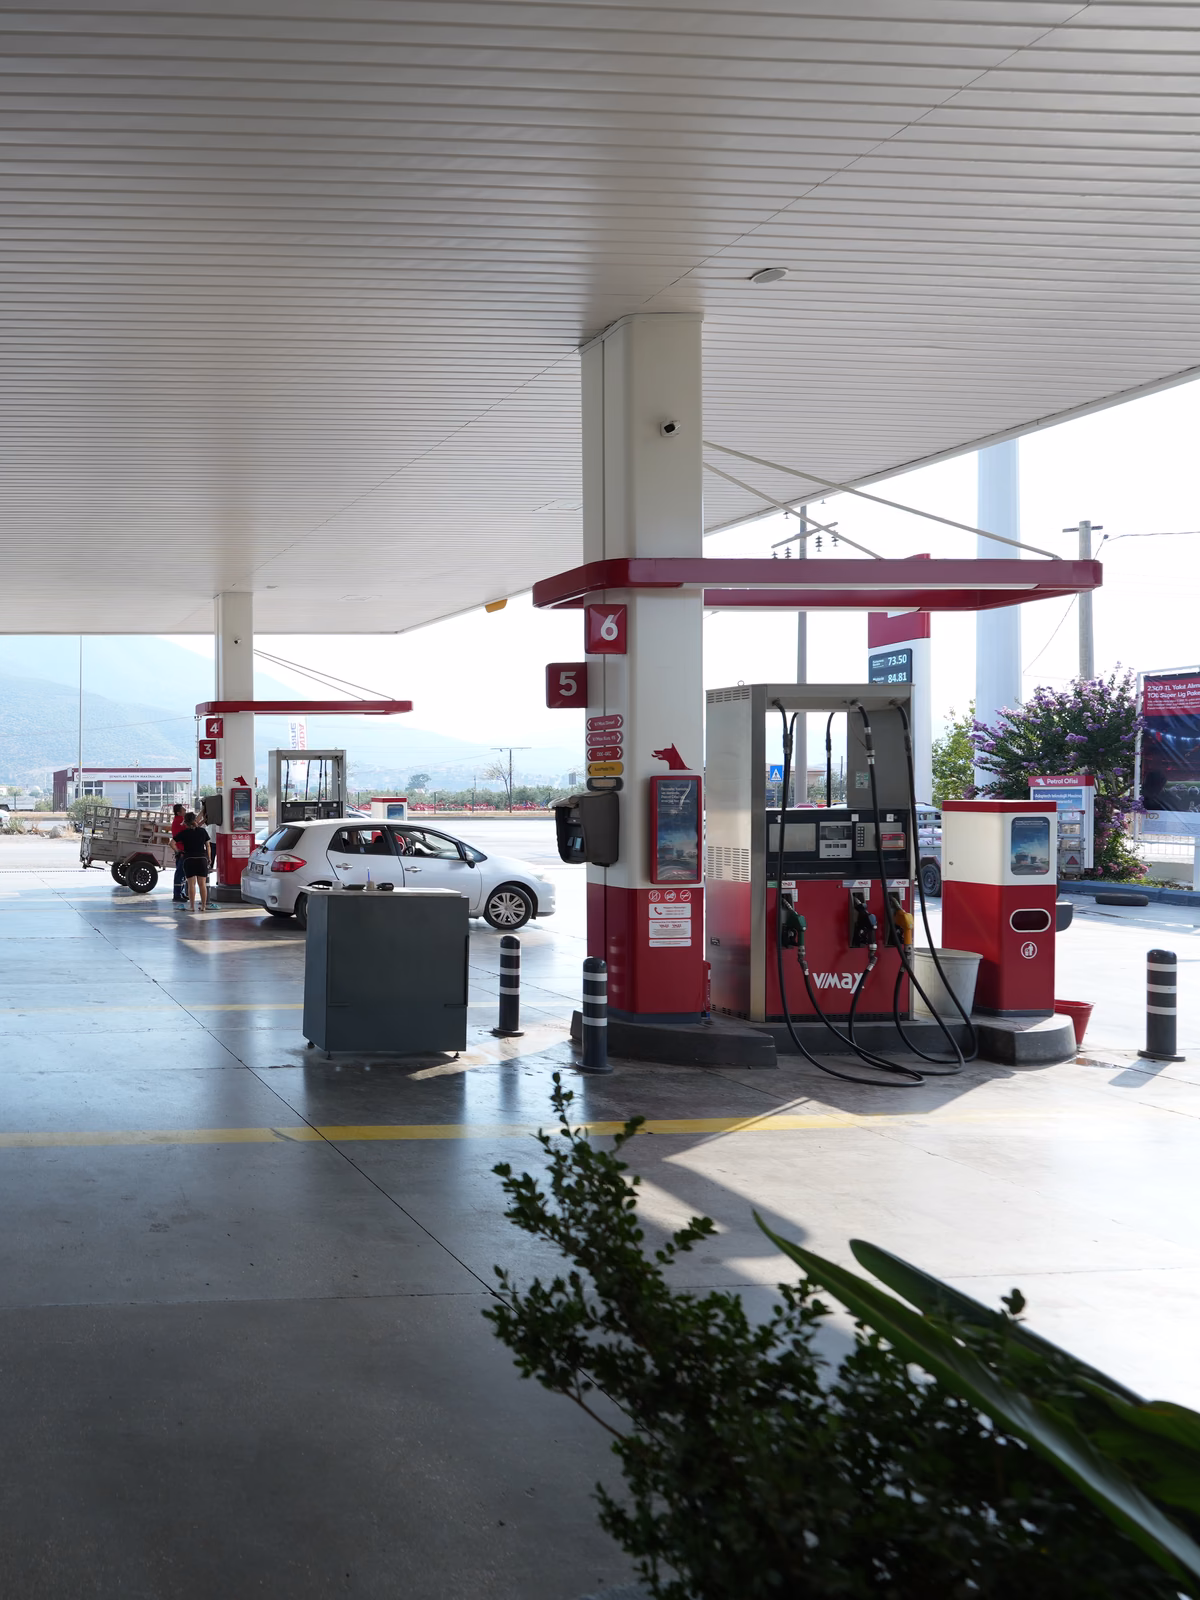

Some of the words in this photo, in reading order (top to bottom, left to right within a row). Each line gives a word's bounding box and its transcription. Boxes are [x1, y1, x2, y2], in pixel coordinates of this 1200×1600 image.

[600, 614, 619, 641] 6
[887, 654, 907, 666] 73.50
[887, 671, 907, 683] 84.81
[559, 671, 578, 697] 5
[209, 722, 219, 734] 4
[203, 743, 212, 755] 3
